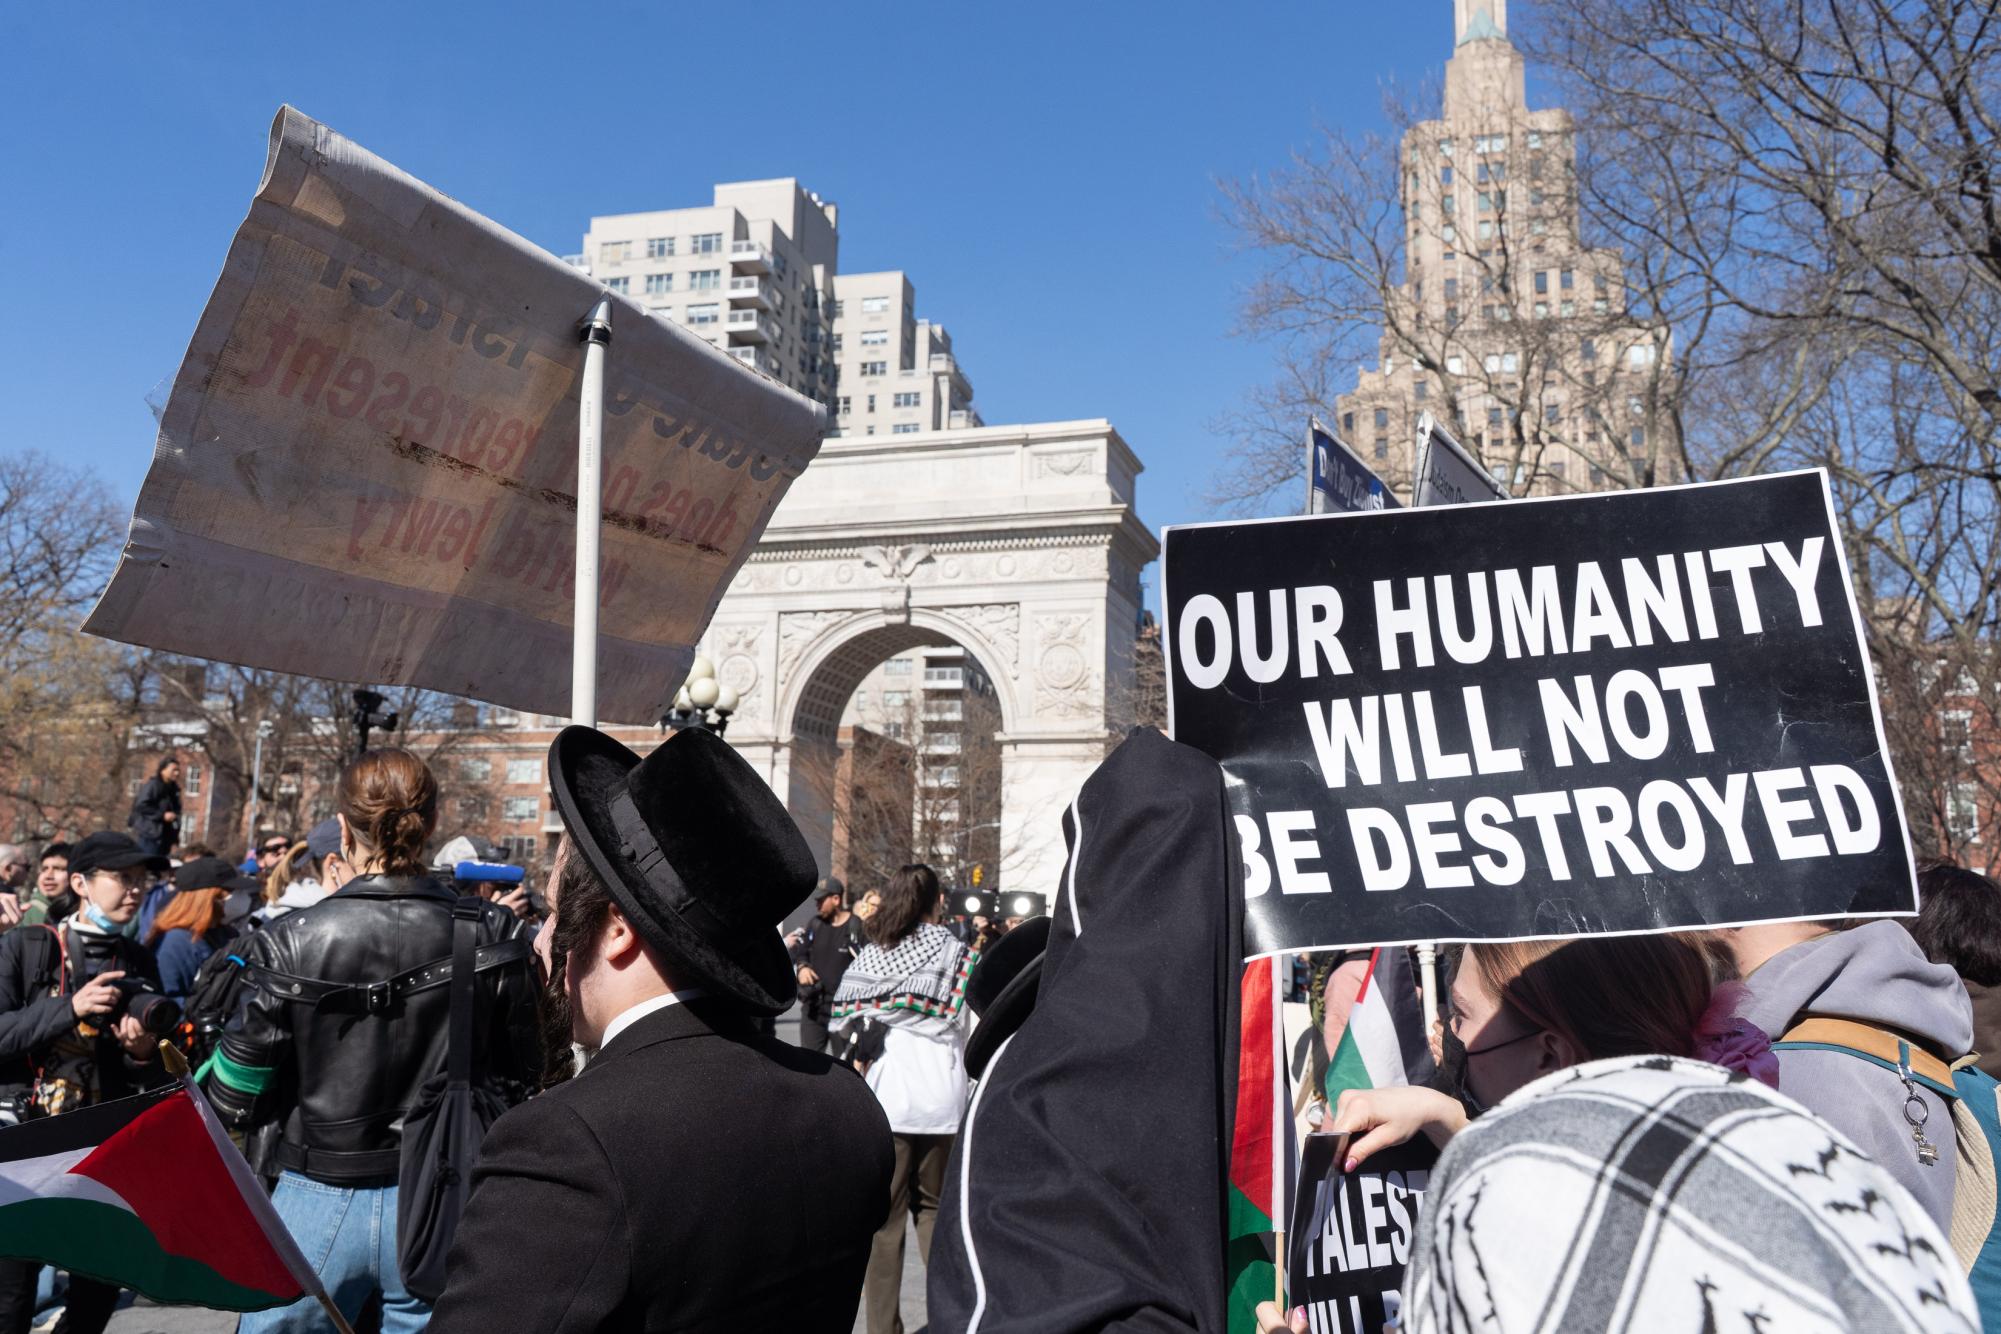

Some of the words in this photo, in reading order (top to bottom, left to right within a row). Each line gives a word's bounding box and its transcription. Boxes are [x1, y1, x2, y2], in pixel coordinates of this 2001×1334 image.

[1178, 585, 1353, 690] OUR
[1373, 536, 1826, 671] HUMANITY
[1303, 685, 1524, 789] WILL
[1537, 663, 1716, 768] NOT
[1233, 809, 1332, 899] BE
[1345, 763, 1883, 892] DESTROYED
